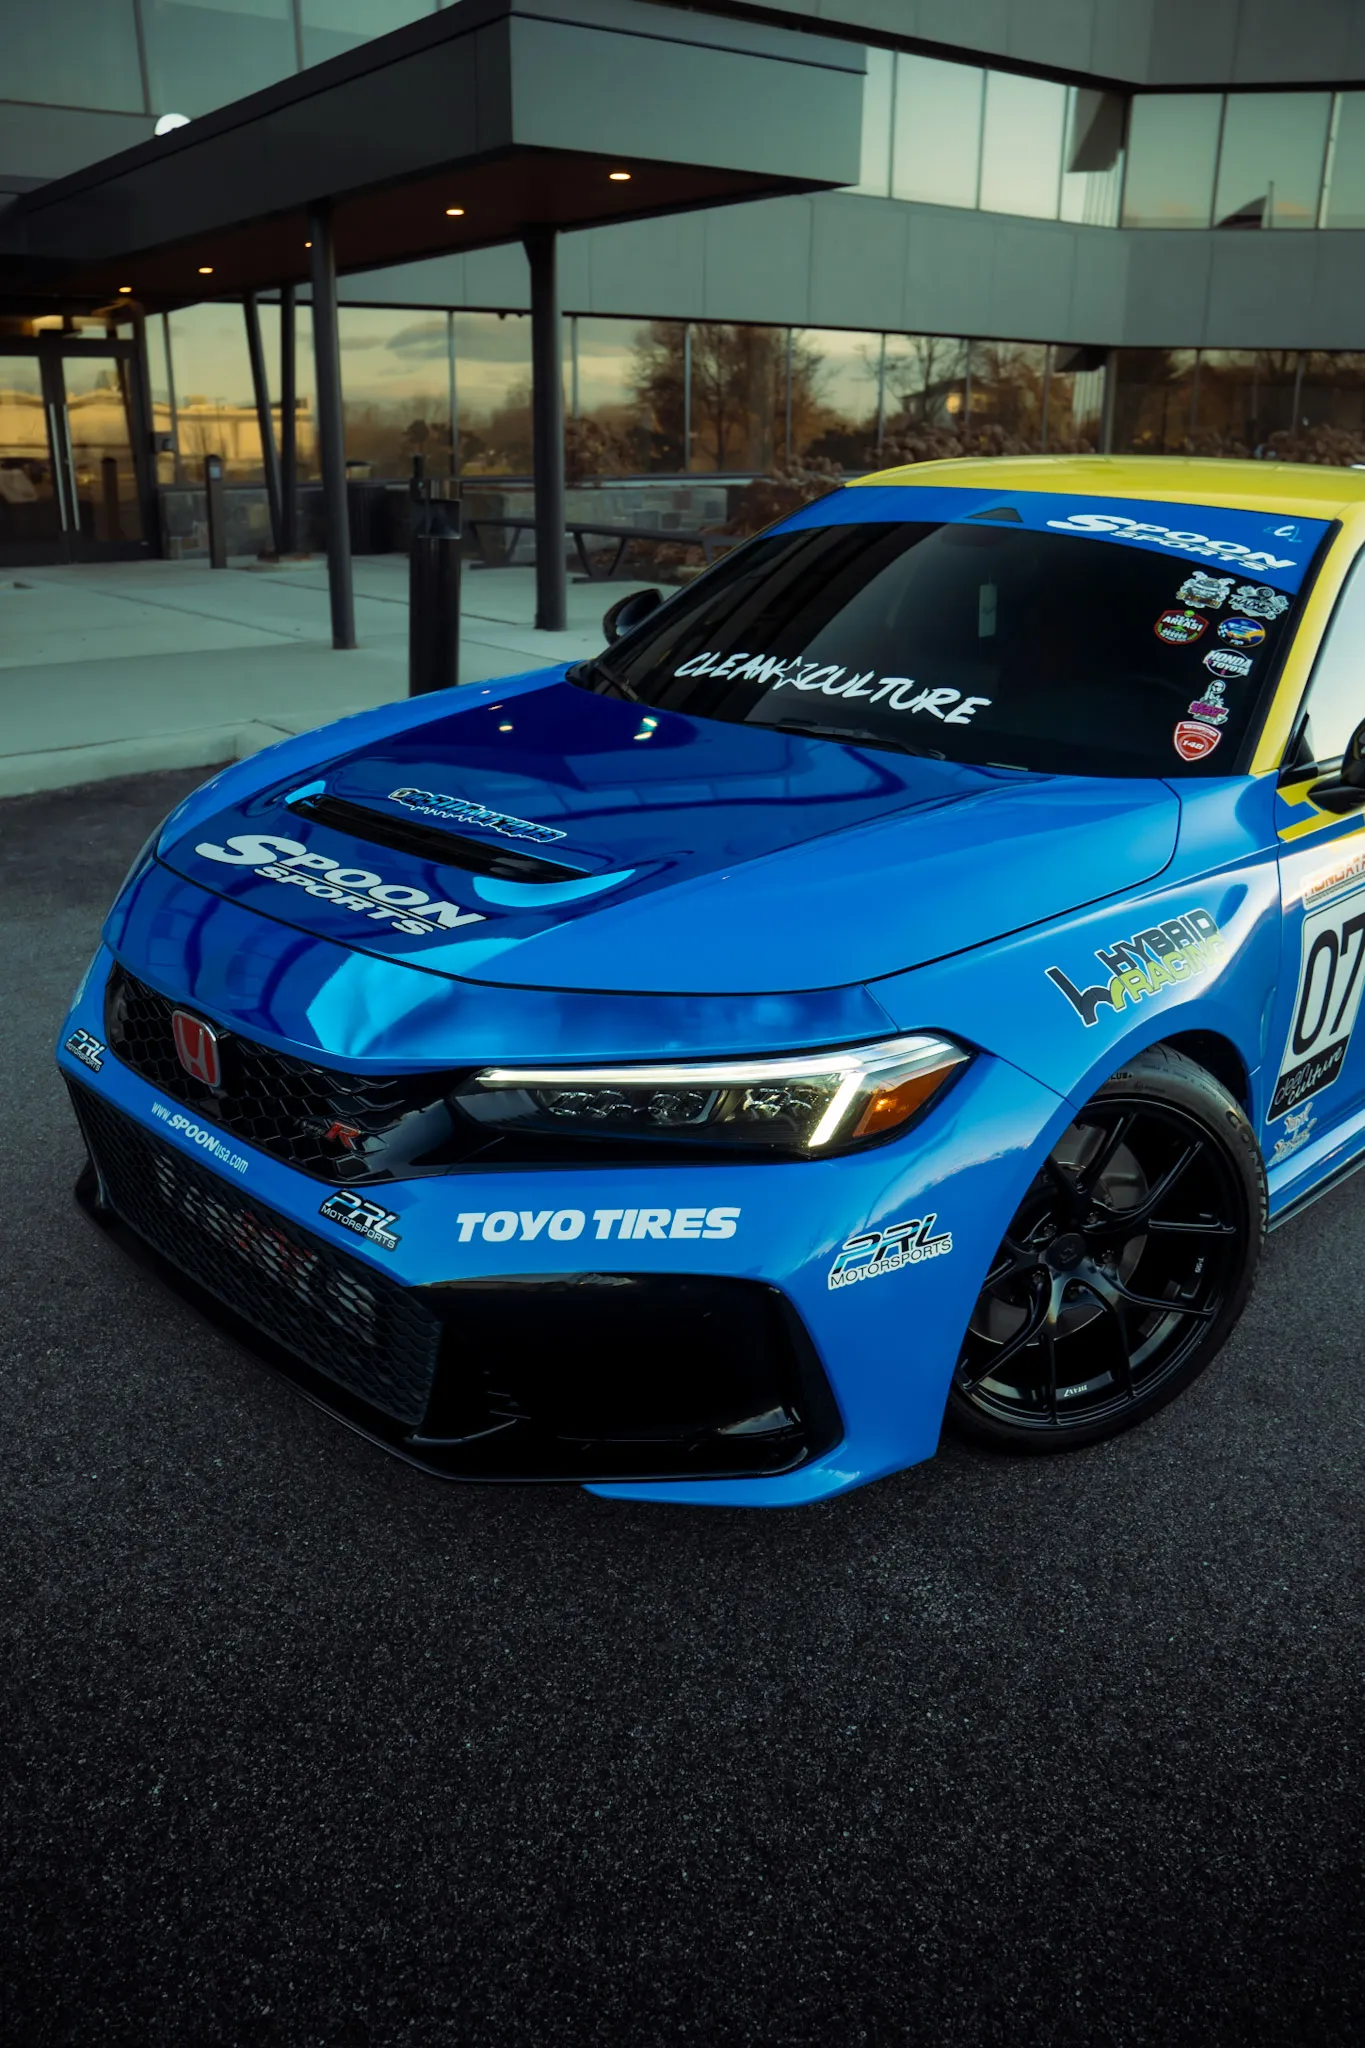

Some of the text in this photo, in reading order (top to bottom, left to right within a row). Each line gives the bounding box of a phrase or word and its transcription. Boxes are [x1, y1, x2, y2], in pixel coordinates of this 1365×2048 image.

[1046, 514, 1297, 568] SPOON
[1110, 531, 1269, 571] SPORTS
[195, 834, 487, 928] SPOON
[254, 866, 434, 935] SPORTS
[1095, 909, 1219, 976] HYBRID
[1118, 933, 1230, 1002] RACING
[1292, 911, 1365, 1056] 07
[68, 1029, 105, 1066] PRL
[151, 1102, 249, 1174] www.SPOONusa.com
[321, 1204, 397, 1249] MOTORSPORTS
[325, 1191, 398, 1241] PRL
[455, 1207, 741, 1242] TOYO TIRES
[830, 1214, 952, 1276] PRL
[829, 1239, 952, 1288] MOTORSPORTS
